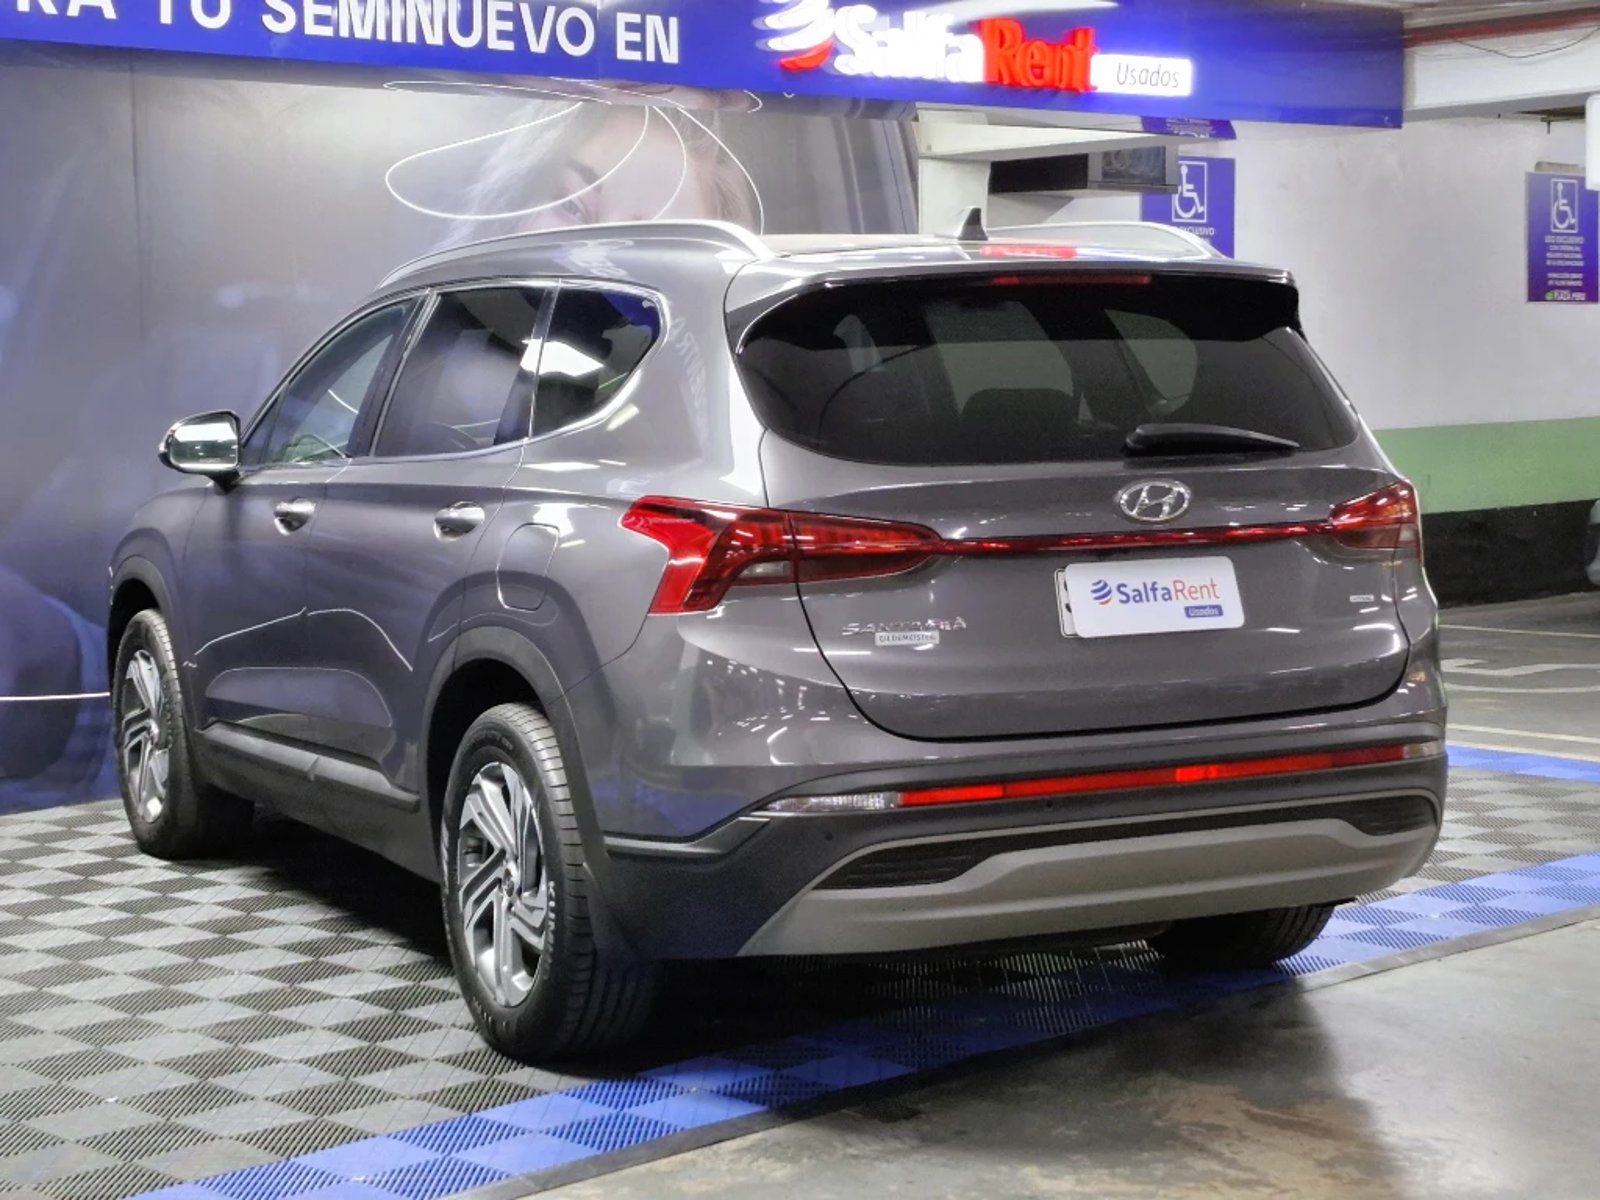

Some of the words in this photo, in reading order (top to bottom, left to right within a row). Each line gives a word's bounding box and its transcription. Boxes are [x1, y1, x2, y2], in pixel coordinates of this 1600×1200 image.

[261, 0, 595, 57] SEMINUEVO
[616, 12, 679, 64] EN
[1116, 63, 1181, 88] Usados
[1115, 578, 1221, 604] SalfaRent
